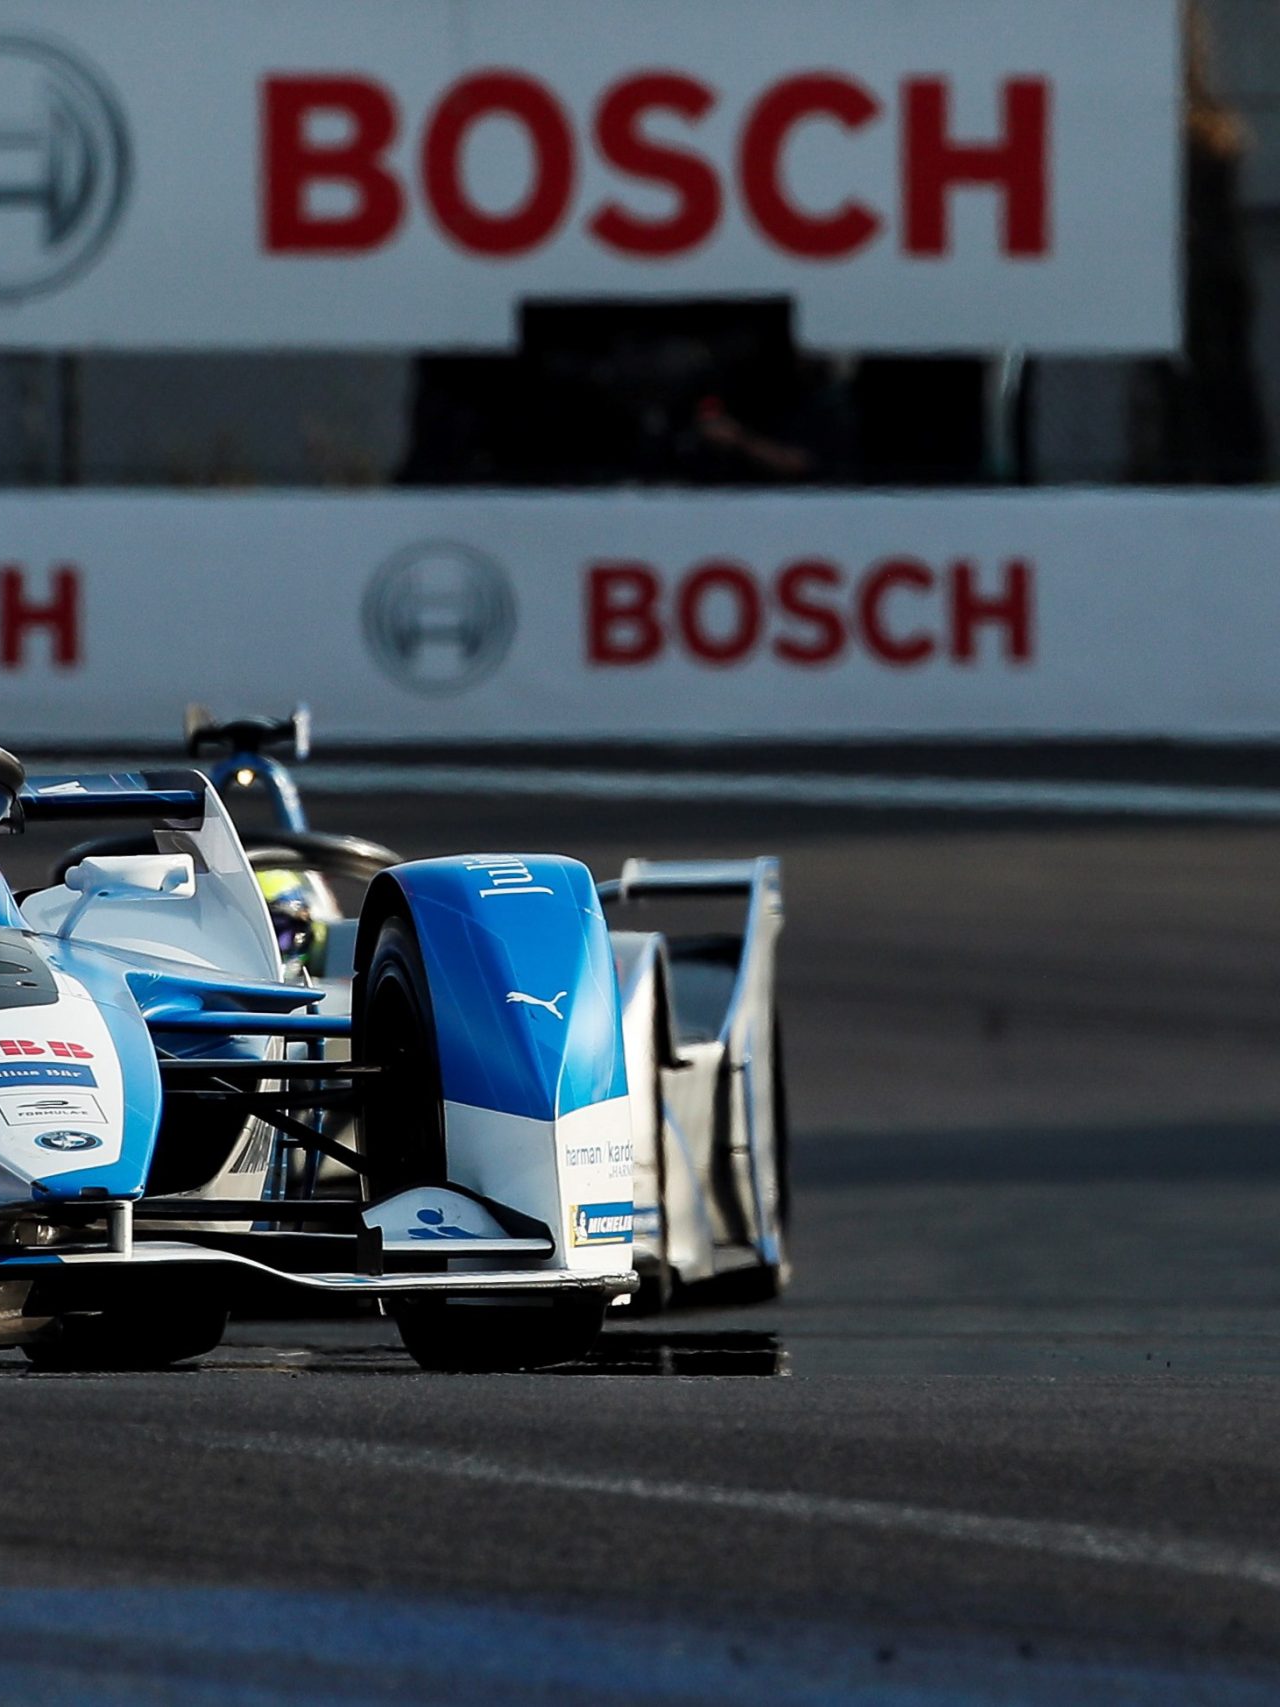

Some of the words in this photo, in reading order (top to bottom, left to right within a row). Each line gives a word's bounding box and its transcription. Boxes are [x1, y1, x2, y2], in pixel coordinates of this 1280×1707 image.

[259, 69, 1052, 262] BOSCH
[586, 559, 1033, 666] BOSCH
[46, 1069, 82, 1078] Bär
[565, 1145, 602, 1166] harman
